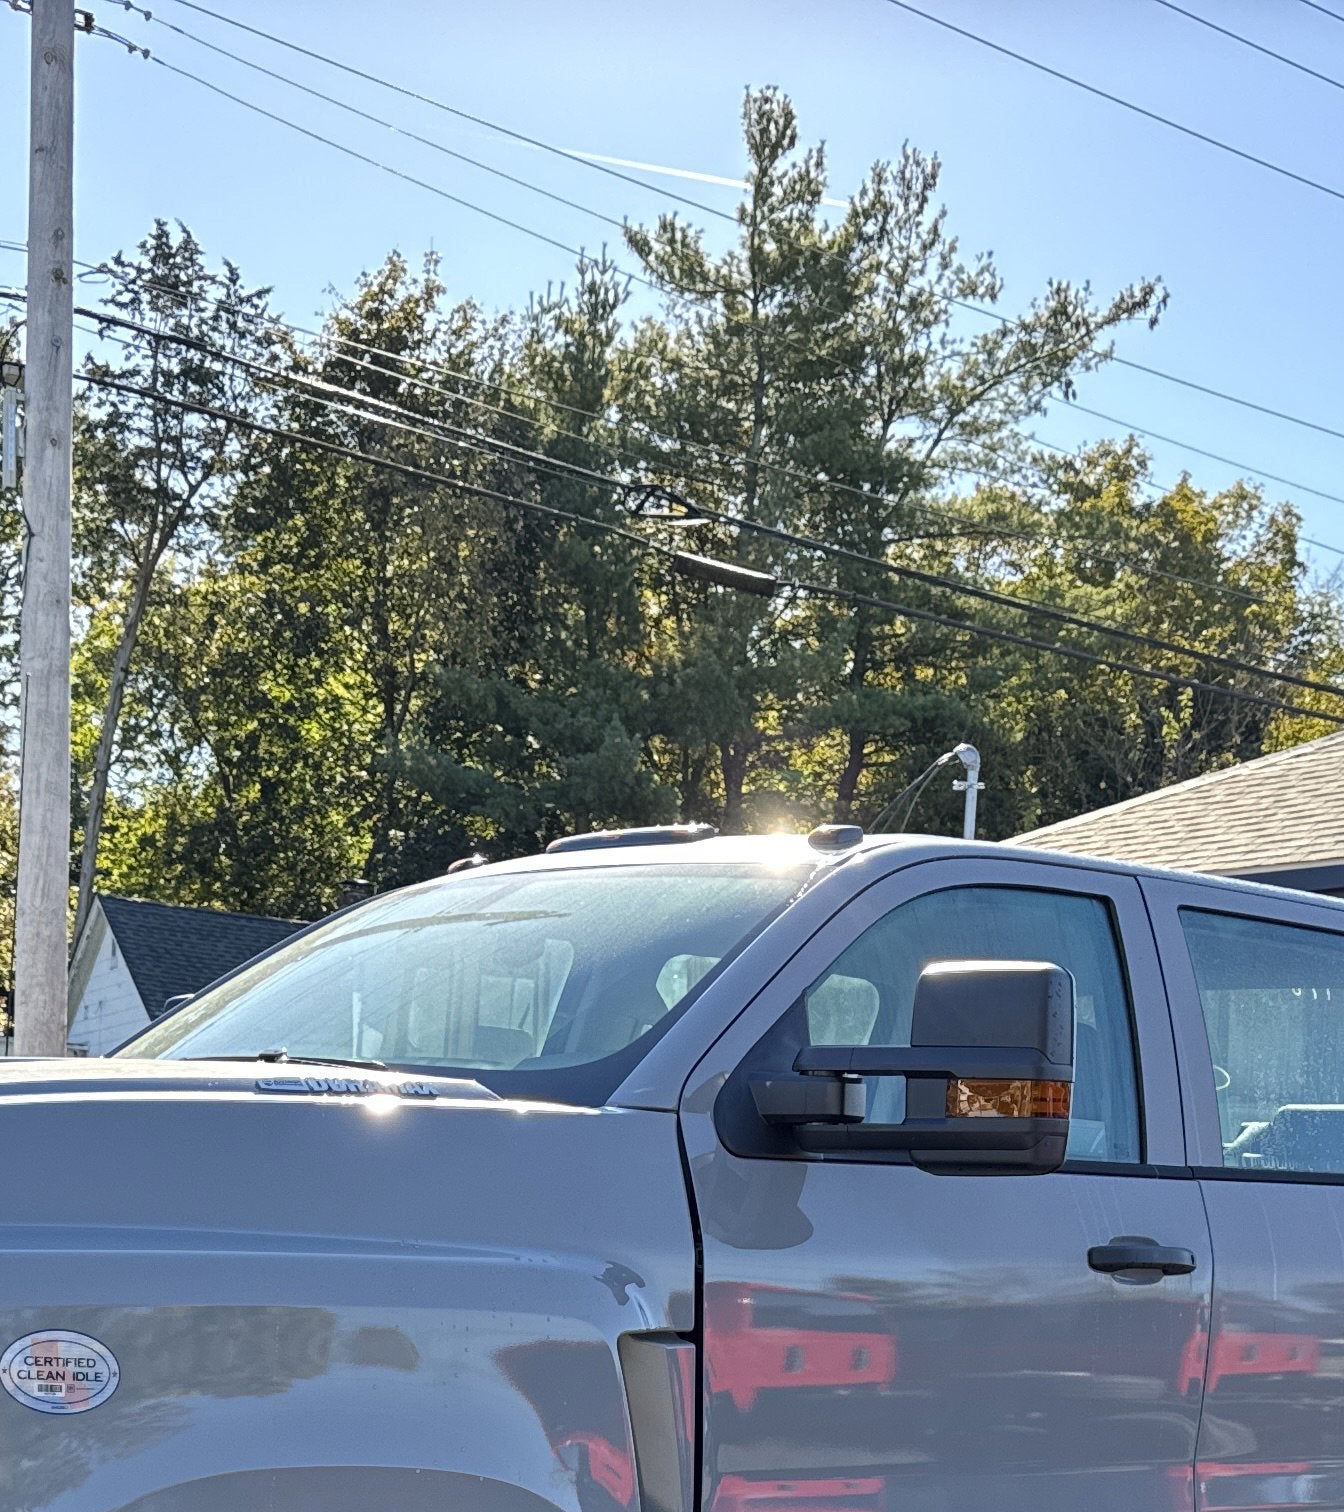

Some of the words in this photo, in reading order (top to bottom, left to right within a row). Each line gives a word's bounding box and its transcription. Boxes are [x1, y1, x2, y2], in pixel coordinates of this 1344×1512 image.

[23, 1355, 97, 1369] CERTIFIED
[17, 1369, 66, 1381] CLEAN
[72, 1371, 104, 1383] IDLE
